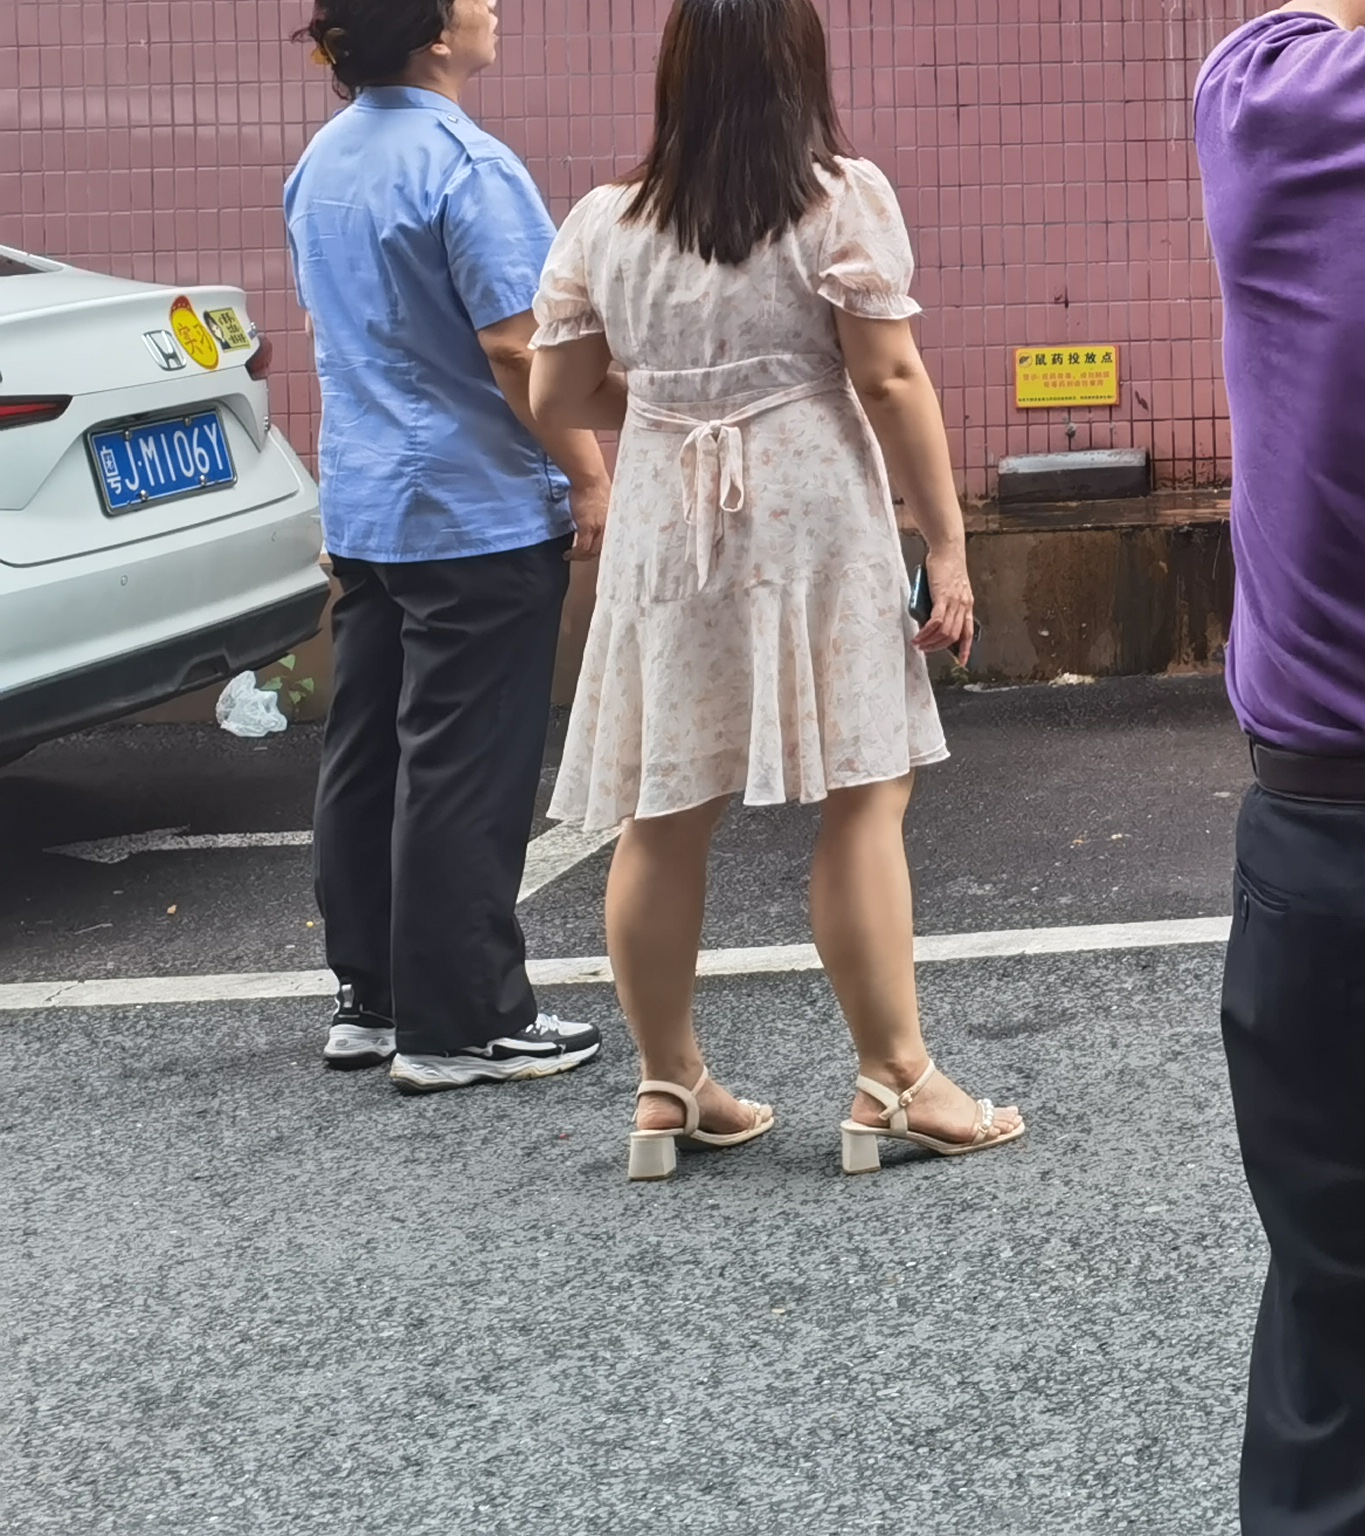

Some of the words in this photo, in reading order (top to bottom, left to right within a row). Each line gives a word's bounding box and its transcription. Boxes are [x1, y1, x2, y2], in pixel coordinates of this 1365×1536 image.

[1035, 351, 1113, 366] 鼠药投放点
